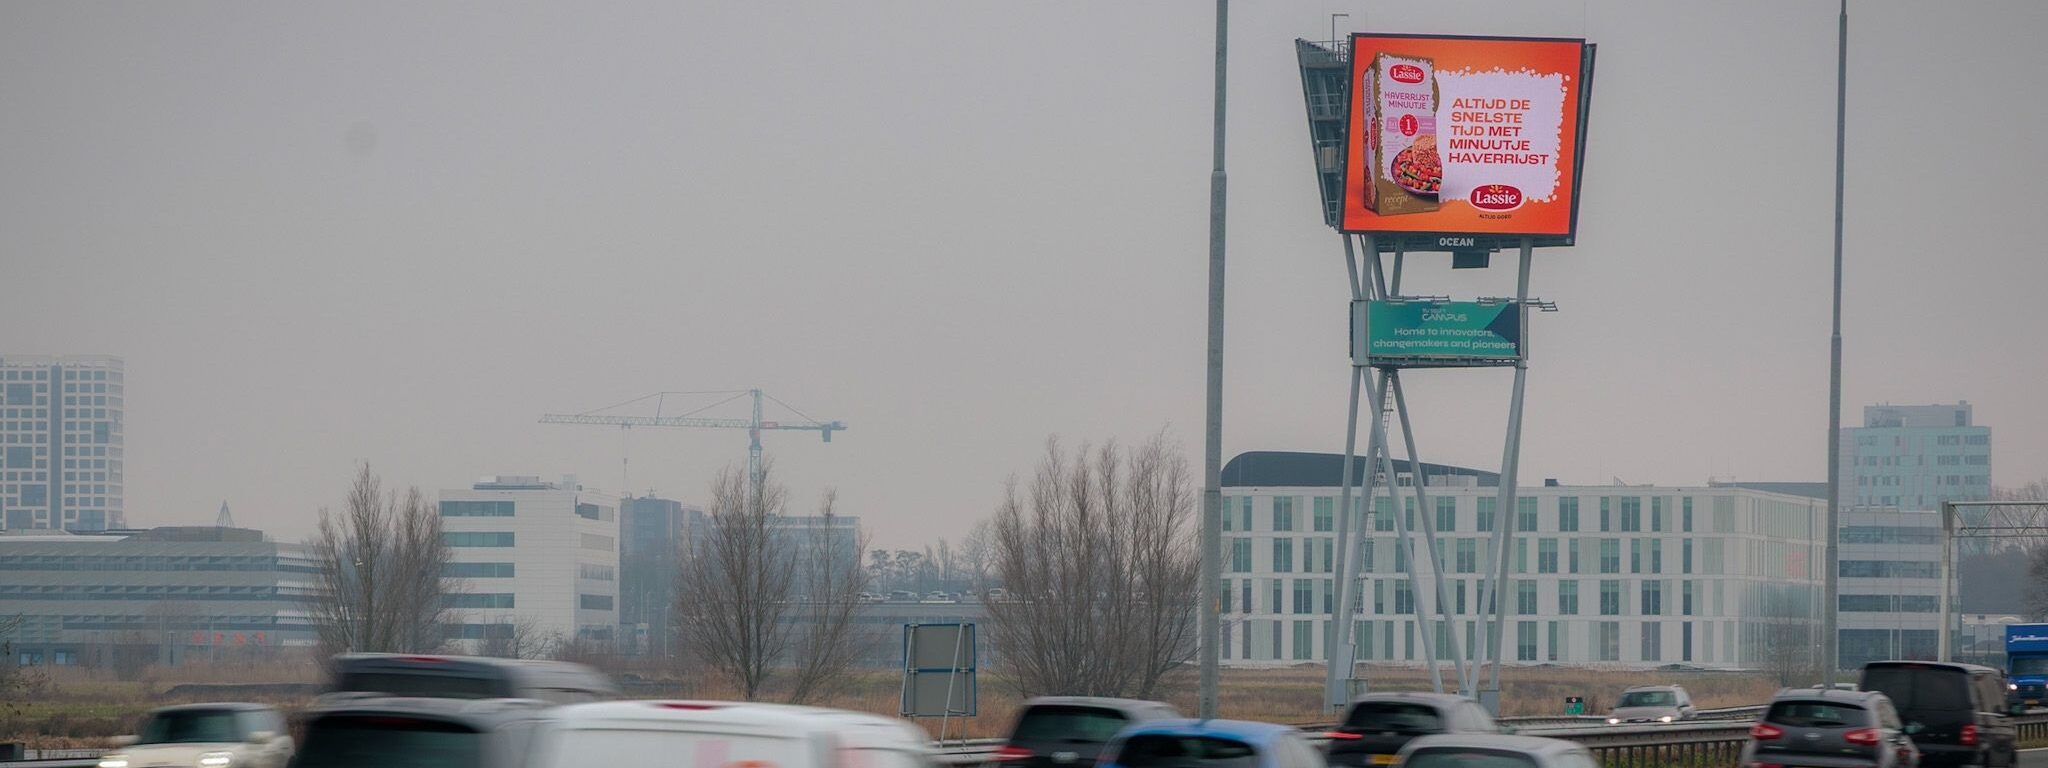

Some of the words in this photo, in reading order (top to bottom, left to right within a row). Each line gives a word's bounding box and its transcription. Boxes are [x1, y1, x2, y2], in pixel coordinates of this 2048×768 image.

[1392, 69, 1422, 81] Lassie
[1384, 91, 1430, 102] HAVERRIJST
[1388, 100, 1427, 110] MINUUTJE
[1452, 98, 1506, 110] ALTIJD
[1510, 99, 1531, 110] DE
[1451, 112, 1523, 123] SNELSTE
[1405, 119, 1412, 130] 1
[1451, 125, 1484, 137] TIJD
[1489, 126, 1522, 137] MET
[1449, 139, 1530, 151] MINUUTJE
[1449, 153, 1549, 165] HAVERRIJST
[1475, 190, 1517, 204] Lassie
[1439, 237, 1474, 247] OCEAN
[1422, 313, 1467, 322] CAMPUS
[1394, 328, 1425, 336] Home
[1427, 328, 1438, 336] to
[1440, 328, 1495, 337] innovators,
[1373, 339, 1449, 349] changemakers
[1450, 340, 1471, 348] and
[1472, 340, 1516, 350] pioneers
